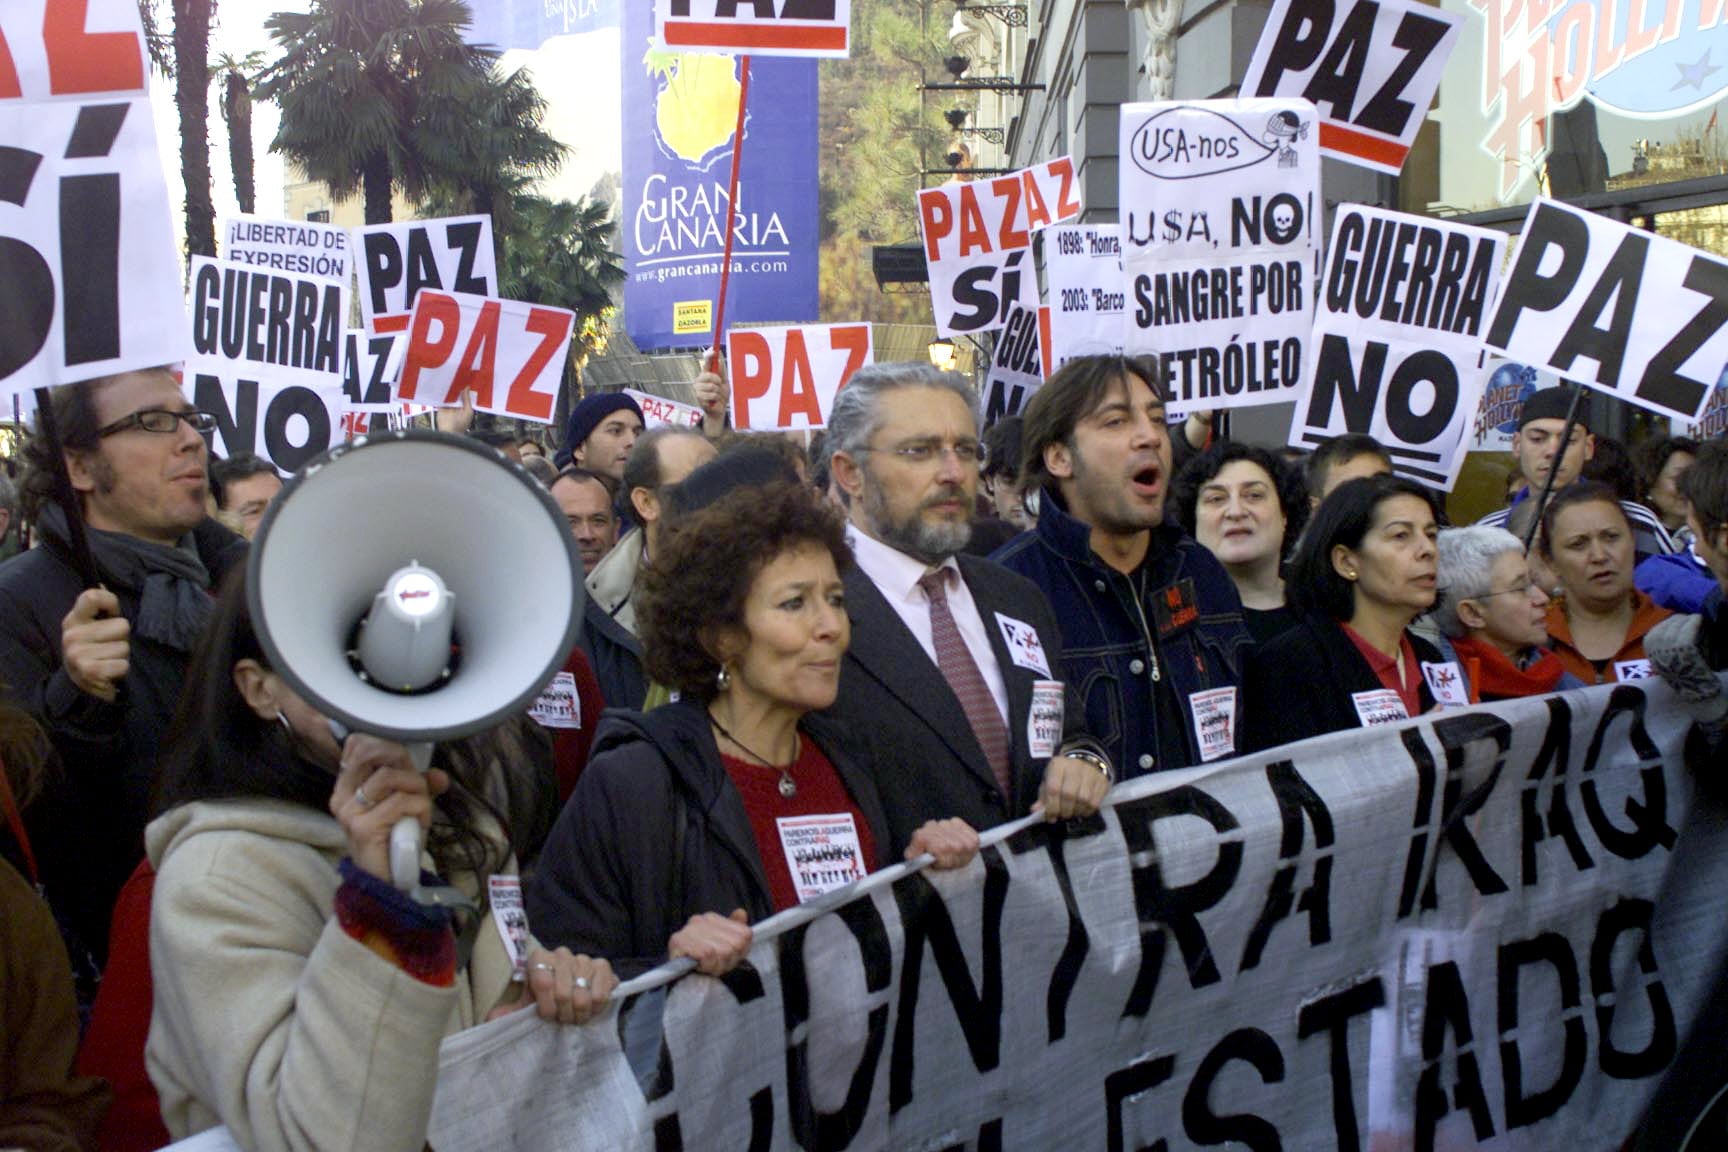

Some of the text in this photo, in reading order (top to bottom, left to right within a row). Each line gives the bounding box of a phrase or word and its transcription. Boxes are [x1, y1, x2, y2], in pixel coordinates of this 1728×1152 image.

[1255, 0, 1452, 137] PAZ
[231, 223, 345, 250] ¡LIBERTAD DE
[635, 200, 790, 256] CANARIA
[643, 174, 742, 223] GRAN
[919, 176, 1030, 262] PAZ
[1022, 158, 1081, 236] AZ
[363, 221, 489, 314] PAZ
[1061, 288, 1089, 312] 2003:
[1134, 260, 1303, 329] SANGRE POR
[1326, 212, 1496, 337] GUERRA
[1488, 201, 1728, 418] PAZ
[193, 264, 341, 374] GUERRA
[397, 291, 573, 420] PAZ
[343, 334, 396, 404] AZ
[642, 398, 675, 424] PAZ
[729, 326, 869, 430] PAZ
[1305, 333, 1460, 445] NO
[194, 372, 332, 474] NO
[617, 684, 1679, 1152] CONTRA IRAQ
[1103, 897, 1679, 1152] ESTADO
